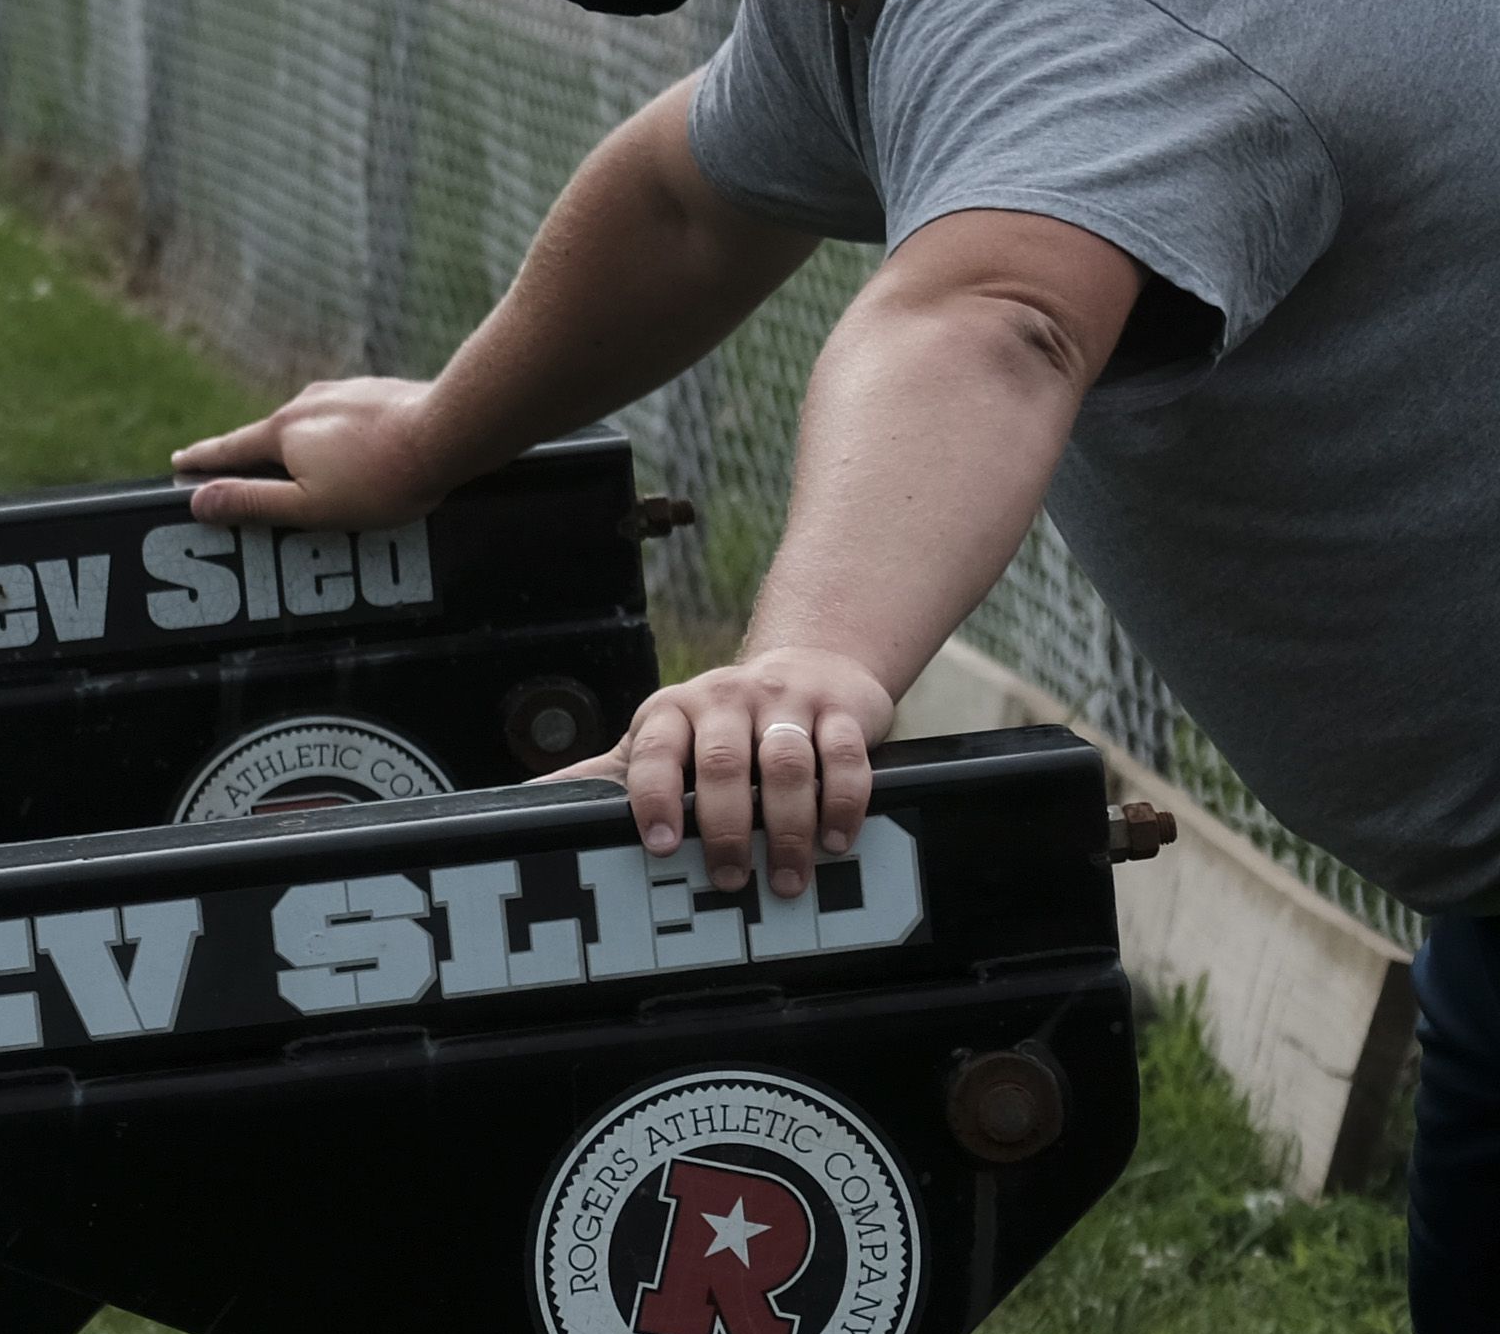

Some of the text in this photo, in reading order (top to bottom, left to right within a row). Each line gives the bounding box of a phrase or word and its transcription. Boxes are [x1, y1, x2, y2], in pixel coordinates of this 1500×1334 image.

[142, 517, 434, 631] Sled
[223, 743, 363, 810] ATHLETIC
[271, 814, 925, 1016] SLED
[568, 1147, 639, 1296] ROGERS
[646, 1104, 823, 1157] ATHLETIC
